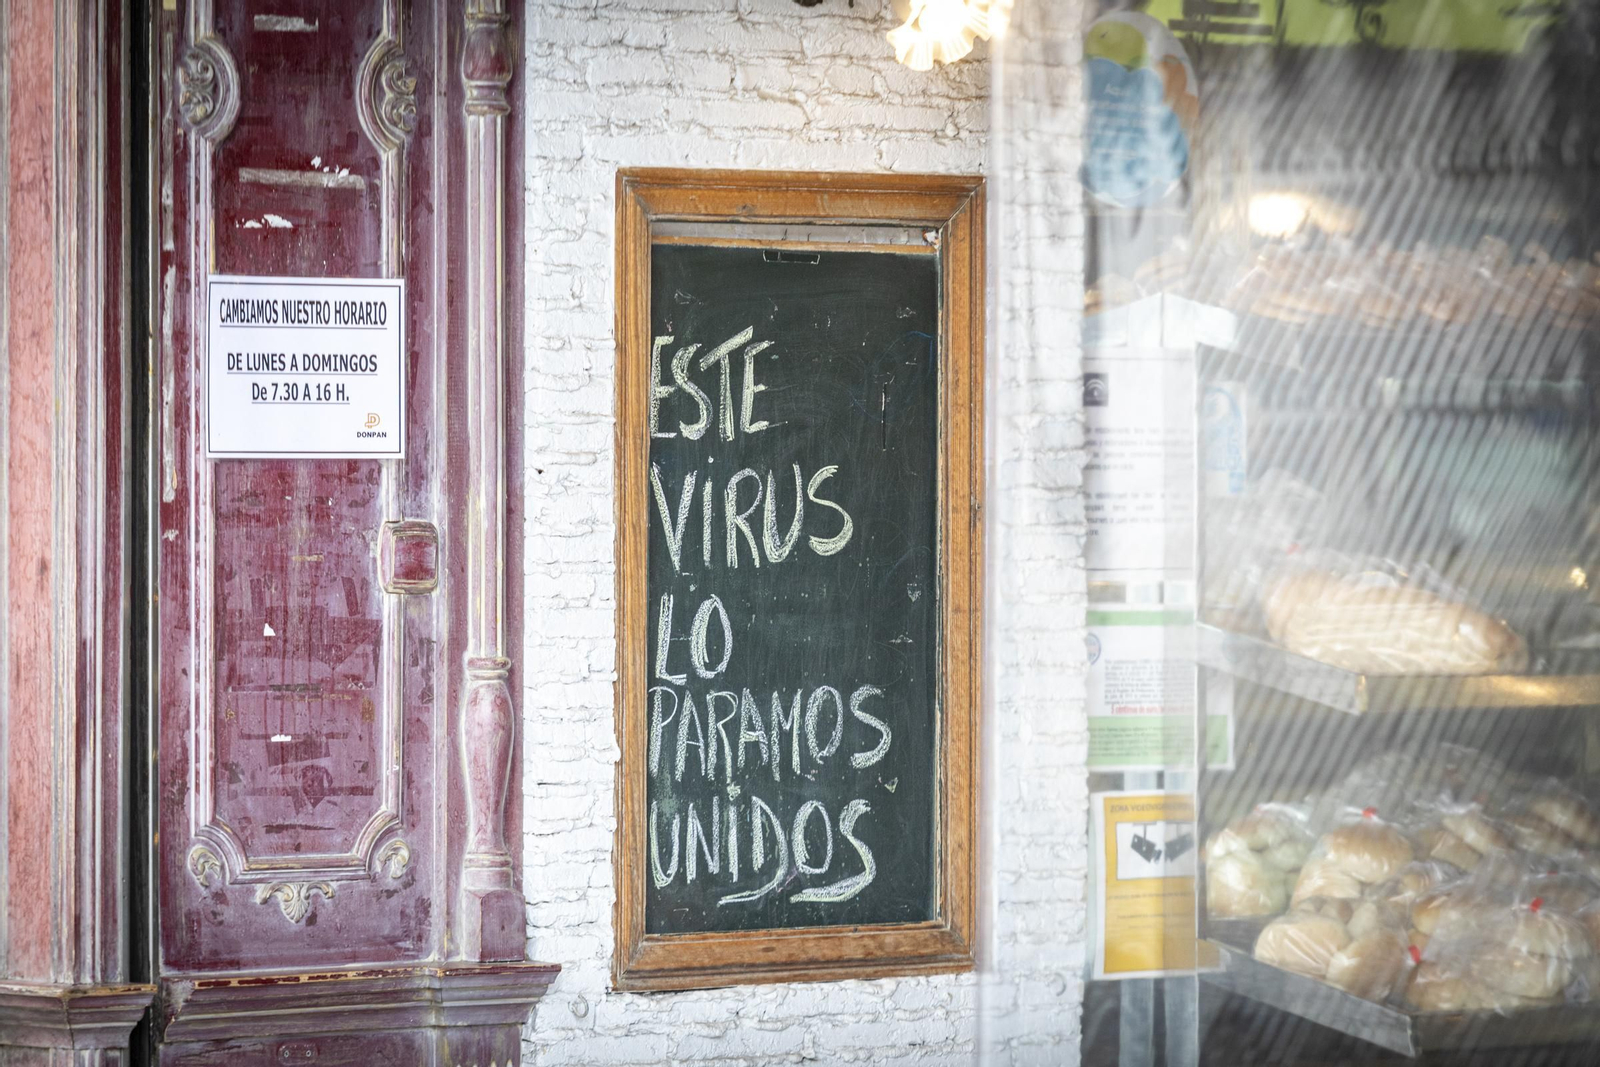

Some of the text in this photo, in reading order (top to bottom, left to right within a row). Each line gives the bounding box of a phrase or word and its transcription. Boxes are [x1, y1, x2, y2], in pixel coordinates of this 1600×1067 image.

[219, 298, 388, 325] CAMBIAMOS NUESTRO HORARIO
[227, 352, 379, 373] DE LUNES A DOMINGOS
[252, 382, 350, 402] De 7.30 A 16 H.
[650, 326, 775, 442] ESTE
[356, 431, 388, 439] DONPAN
[655, 593, 733, 686] LO
[649, 685, 892, 783] PARAMOS
